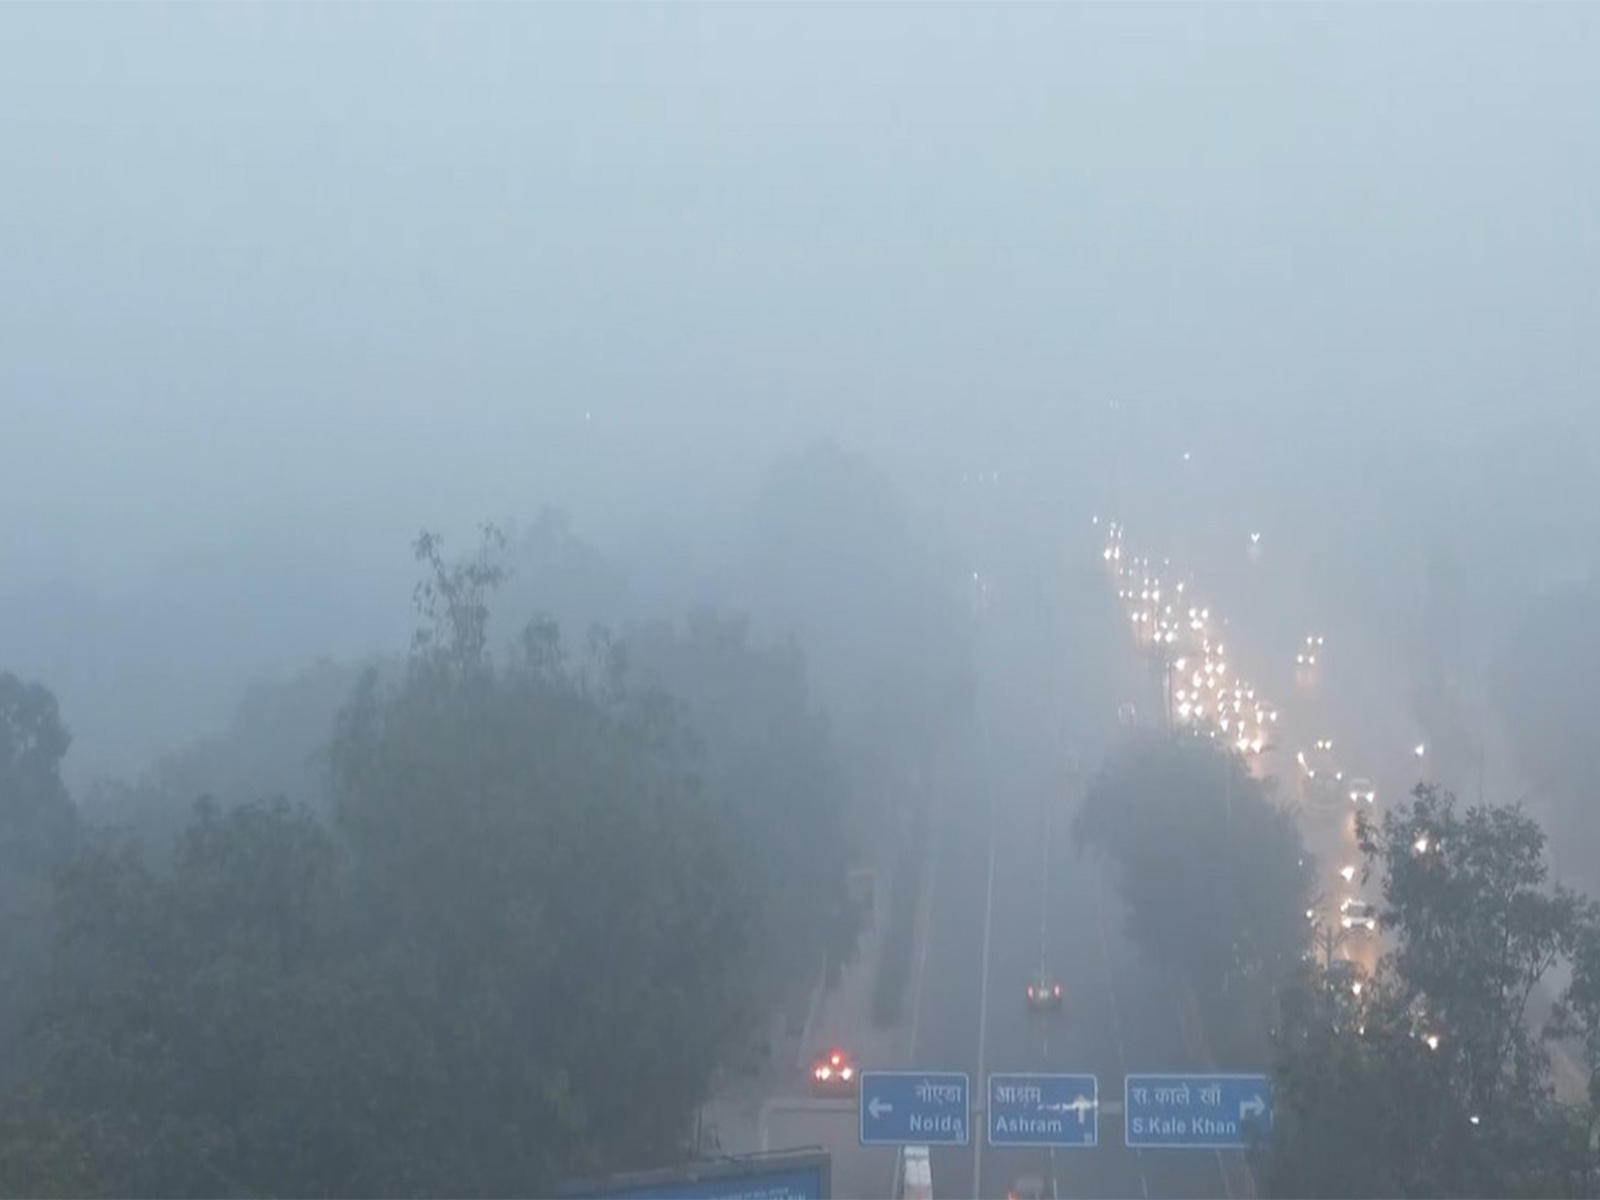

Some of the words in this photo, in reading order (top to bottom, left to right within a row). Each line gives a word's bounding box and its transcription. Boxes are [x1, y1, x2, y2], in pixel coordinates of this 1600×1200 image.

[915, 1080, 962, 1105] नोएडा
[996, 1084, 1041, 1106] आश्रम
[909, 1114, 962, 1133] Noida
[996, 1115, 1062, 1134] Ashram
[1192, 1116, 1236, 1134] Khan
